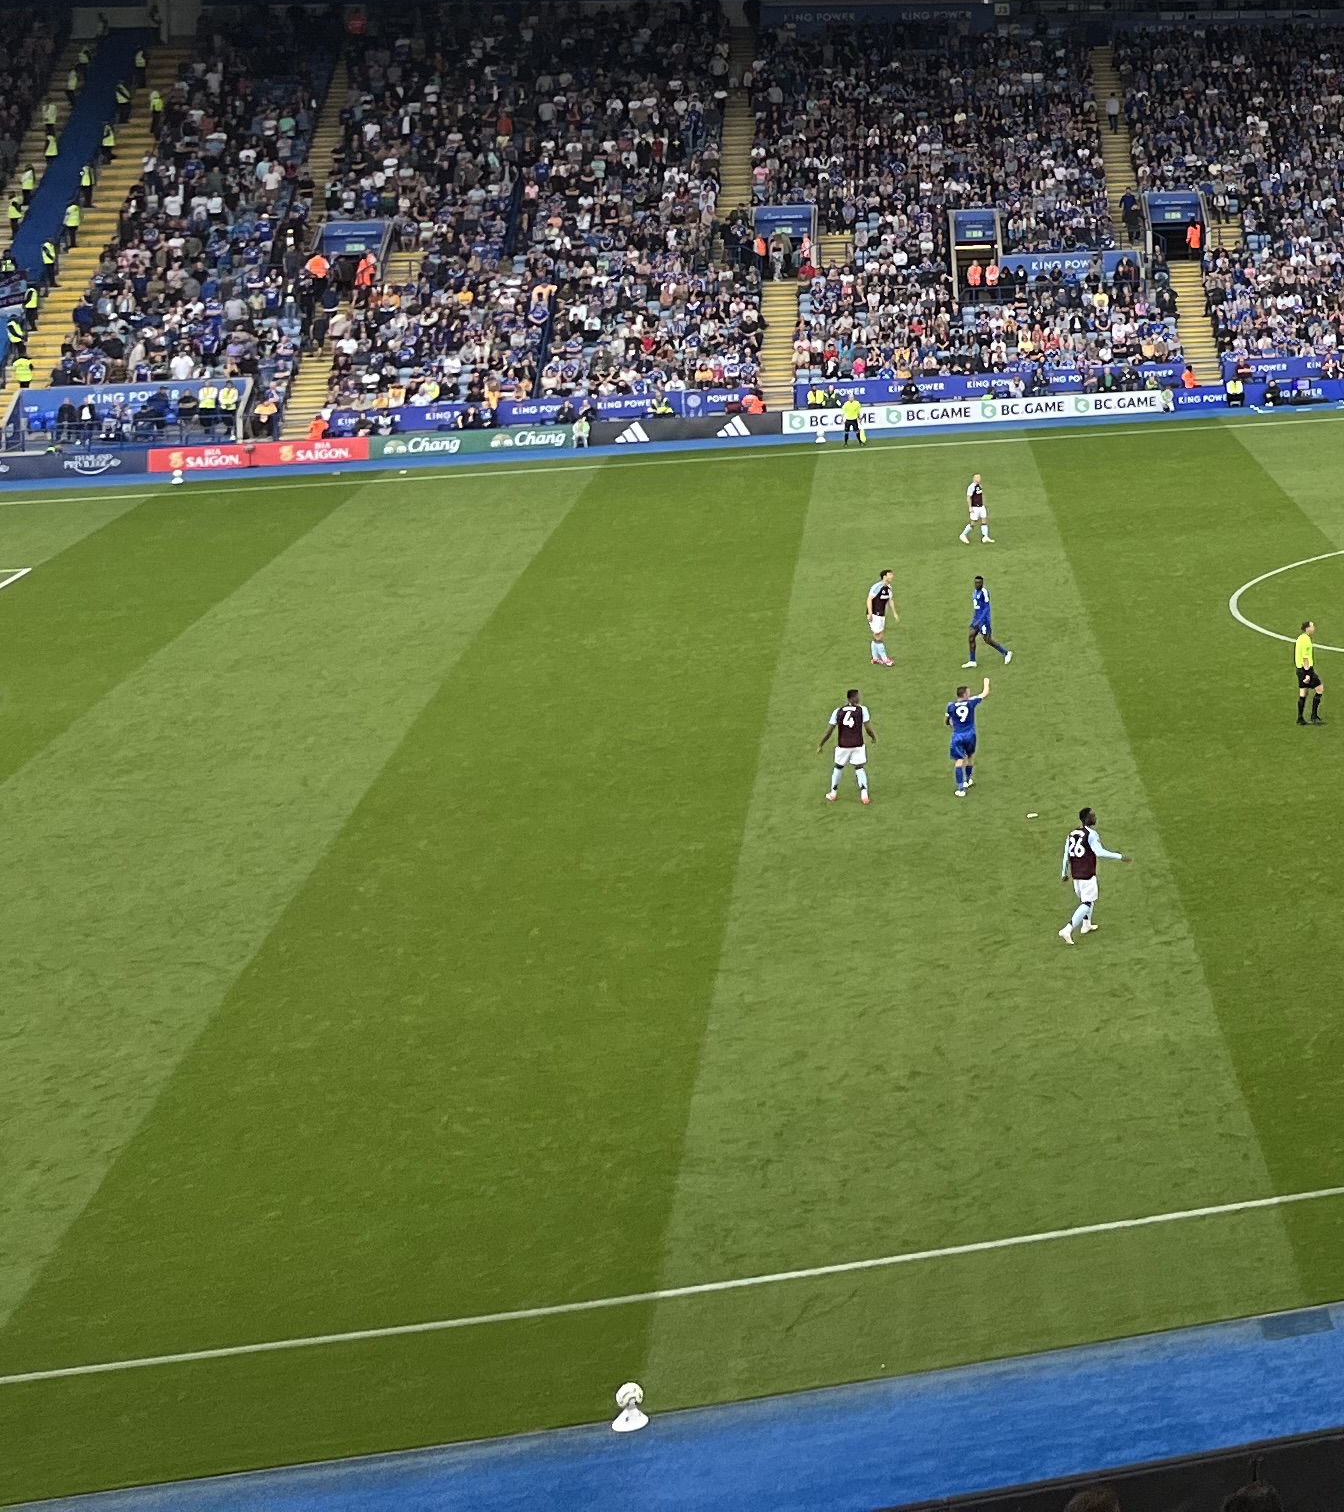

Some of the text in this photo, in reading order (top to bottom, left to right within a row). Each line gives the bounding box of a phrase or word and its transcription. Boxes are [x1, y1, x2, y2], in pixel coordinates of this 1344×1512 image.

[1258, 363, 1287, 373] POWER
[623, 399, 650, 409] POWE
[707, 393, 740, 403] POWER
[1094, 396, 1156, 410] BC.GAME
[1178, 394, 1202, 404] KING
[906, 407, 971, 421] BC.GAME
[1001, 401, 1065, 416] BC.GAME
[408, 436, 461, 454] Chang
[514, 430, 566, 447] Chang
[843, 710, 855, 728] 4
[955, 705, 969, 723] 9
[1069, 836, 1086, 858] 26
